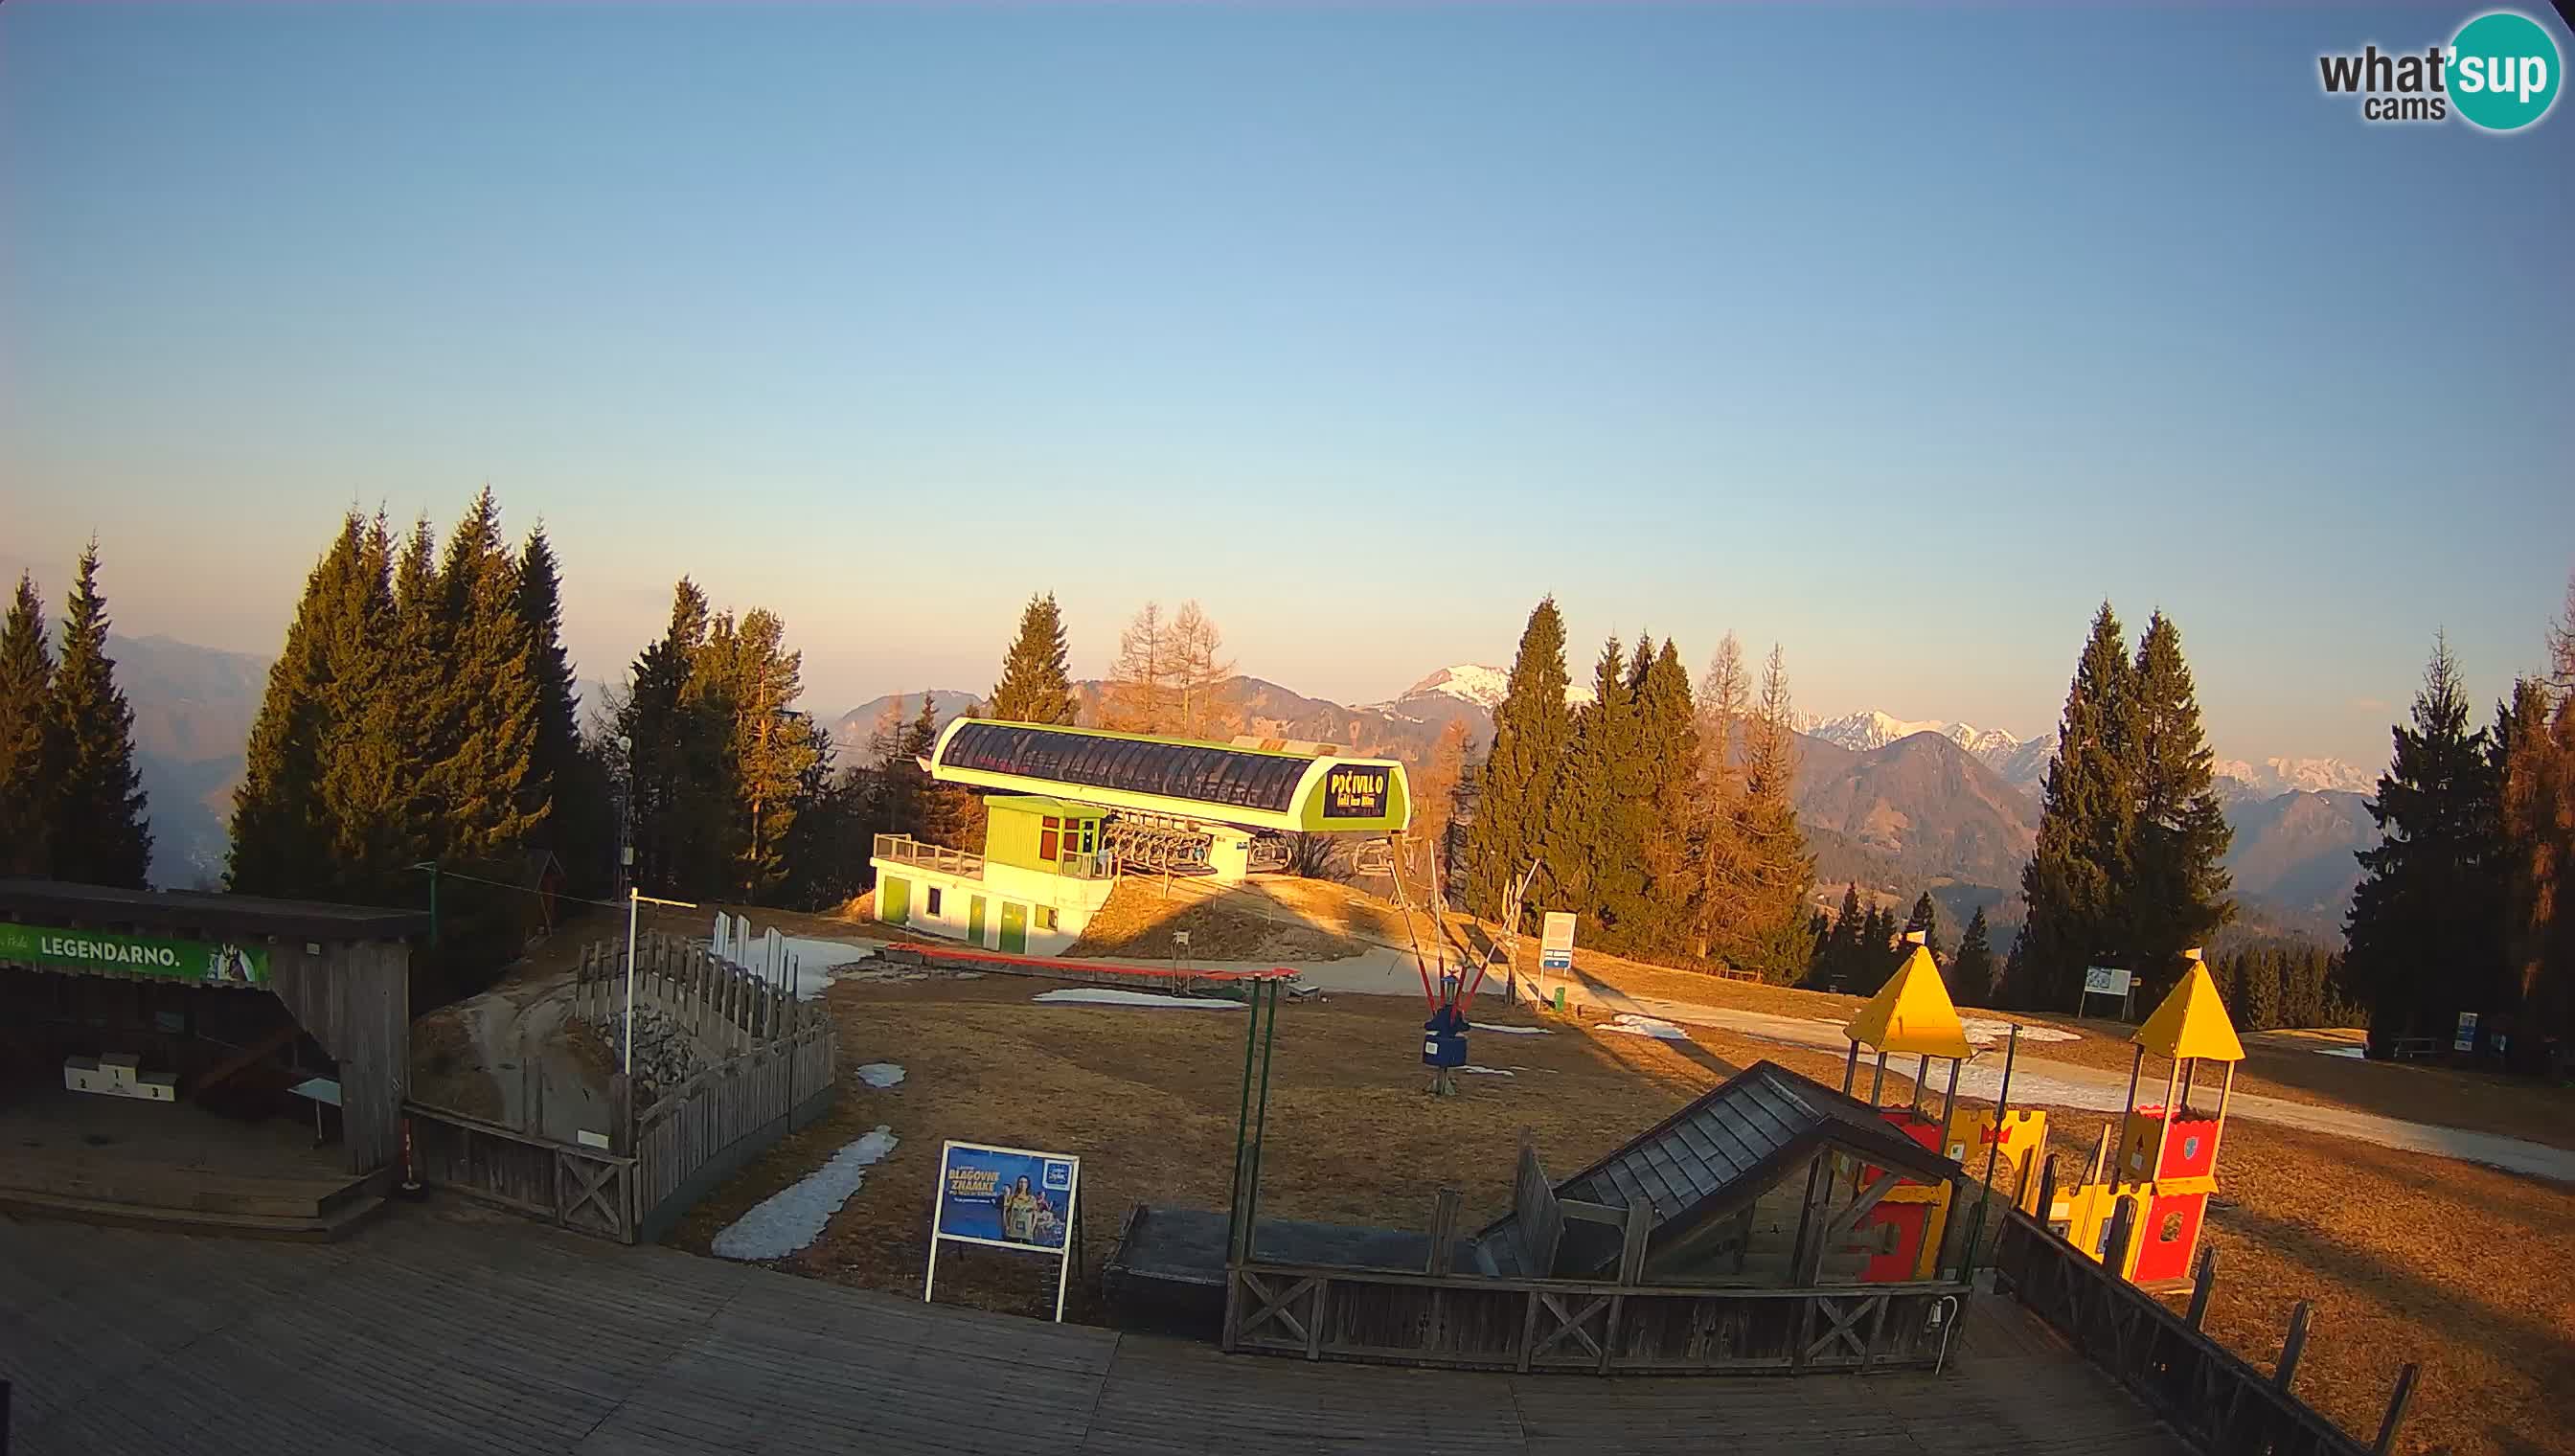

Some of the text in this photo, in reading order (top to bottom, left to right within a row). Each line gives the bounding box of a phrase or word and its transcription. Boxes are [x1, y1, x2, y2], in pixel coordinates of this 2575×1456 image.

[41, 936, 181, 967] LEGENDARNO.
[948, 1169, 1000, 1181] BLAGOVNE
[952, 1179, 996, 1192] ZNAMKE
